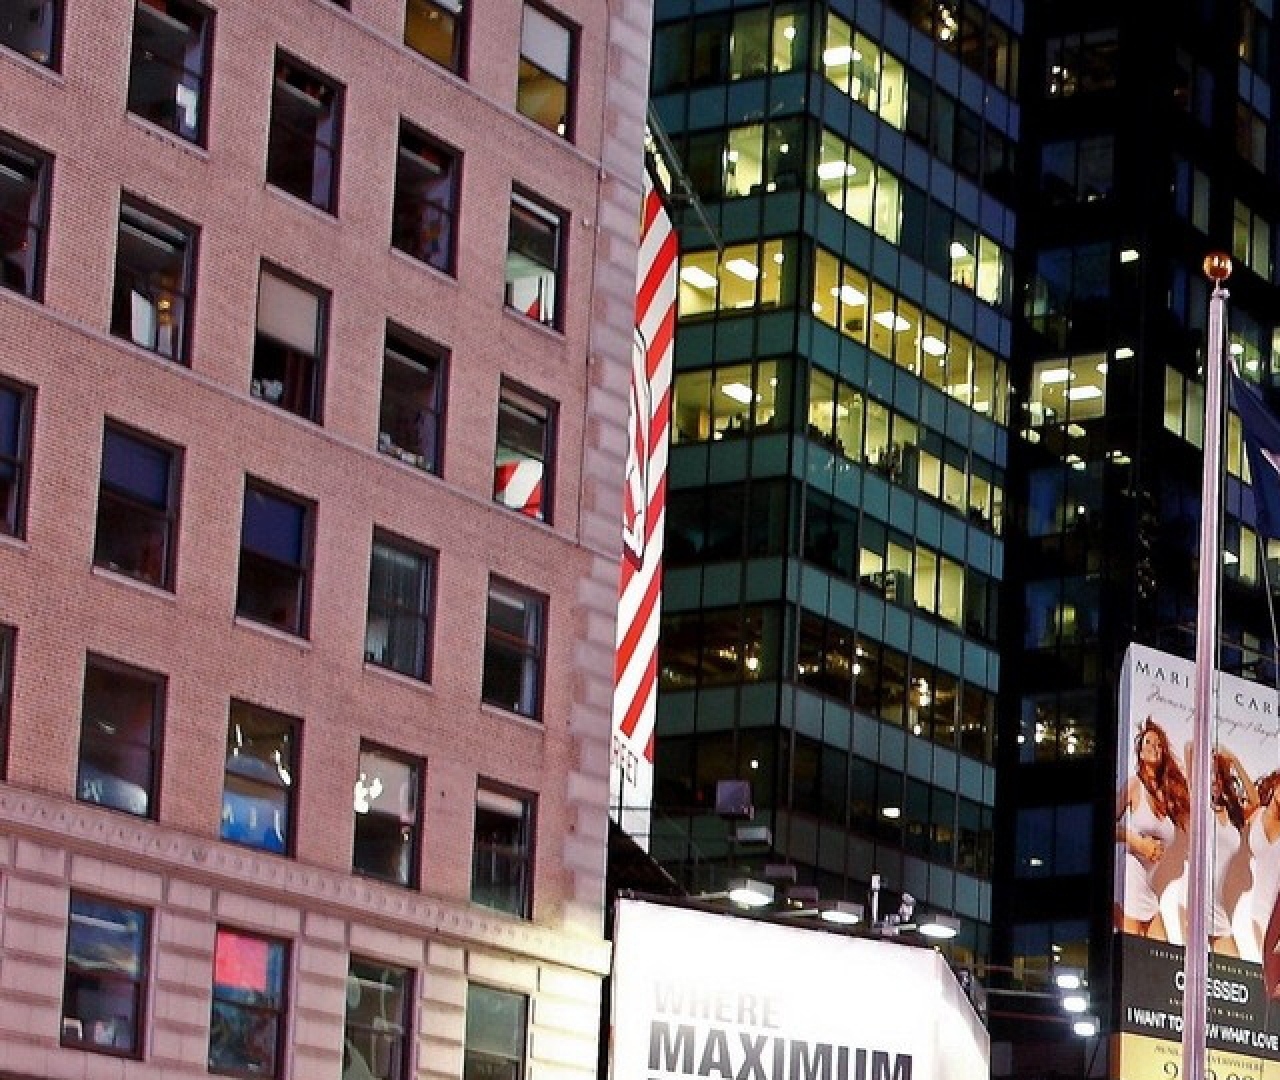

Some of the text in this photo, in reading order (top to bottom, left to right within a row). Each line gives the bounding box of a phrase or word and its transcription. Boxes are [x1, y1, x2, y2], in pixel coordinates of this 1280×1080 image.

[656, 982, 781, 1030] WHERE
[1175, 970, 1249, 1003] OESSED
[1132, 1008, 1168, 1029] WANT
[1220, 1026, 1250, 1045] WHAT
[1251, 1032, 1279, 1051] LOVE
